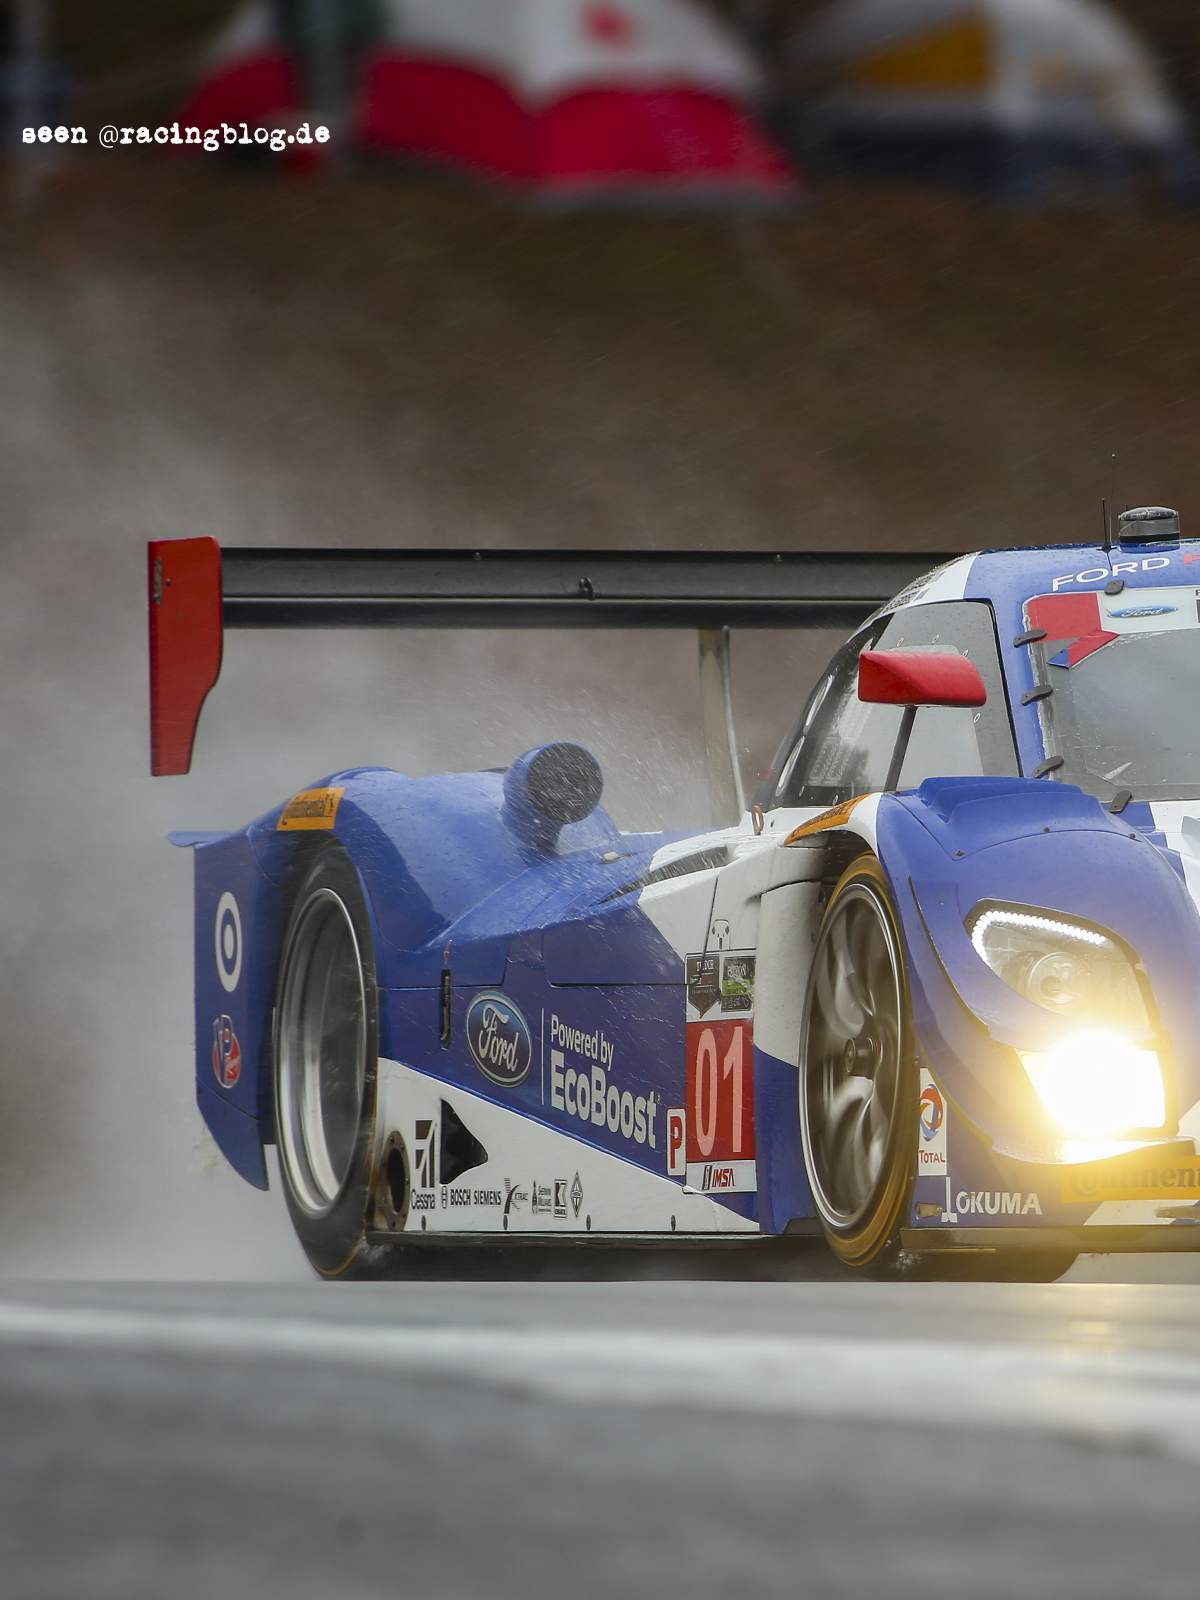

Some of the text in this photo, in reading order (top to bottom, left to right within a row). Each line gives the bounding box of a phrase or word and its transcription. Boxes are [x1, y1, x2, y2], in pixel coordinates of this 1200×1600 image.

[1052, 557, 1171, 591] FORD
[551, 1013, 615, 1072] Powered by
[551, 1048, 658, 1150] EcoBoost
[695, 1025, 744, 1157] 01
[669, 1115, 683, 1169] P
[919, 1149, 946, 1164] TOTAL
[712, 1167, 735, 1188] IMSA
[411, 1188, 436, 1210] Cessna
[450, 1188, 502, 1206] BOSCH SIEMENS
[955, 1191, 1043, 1216] OKUMA
